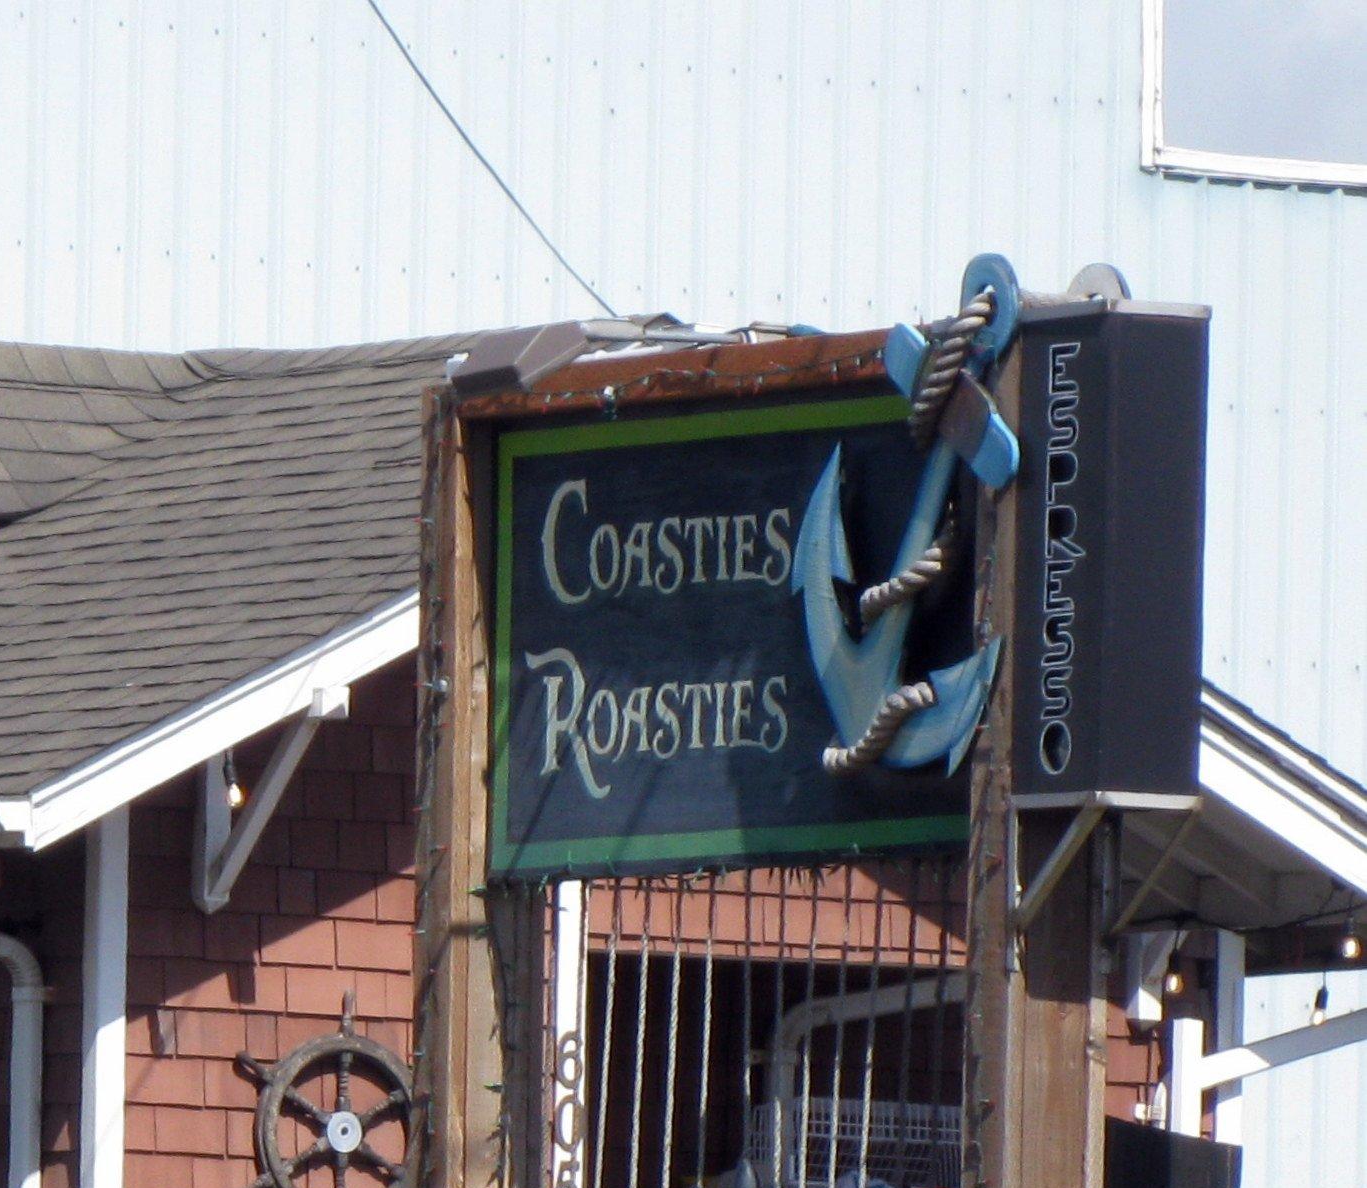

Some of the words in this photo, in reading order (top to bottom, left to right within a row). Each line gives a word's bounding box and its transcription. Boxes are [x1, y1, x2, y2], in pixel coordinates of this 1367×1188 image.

[542, 479, 794, 605] COASTIES
[1039, 341, 1086, 776] ESPRESSO
[525, 646, 788, 798] ROASTIES
